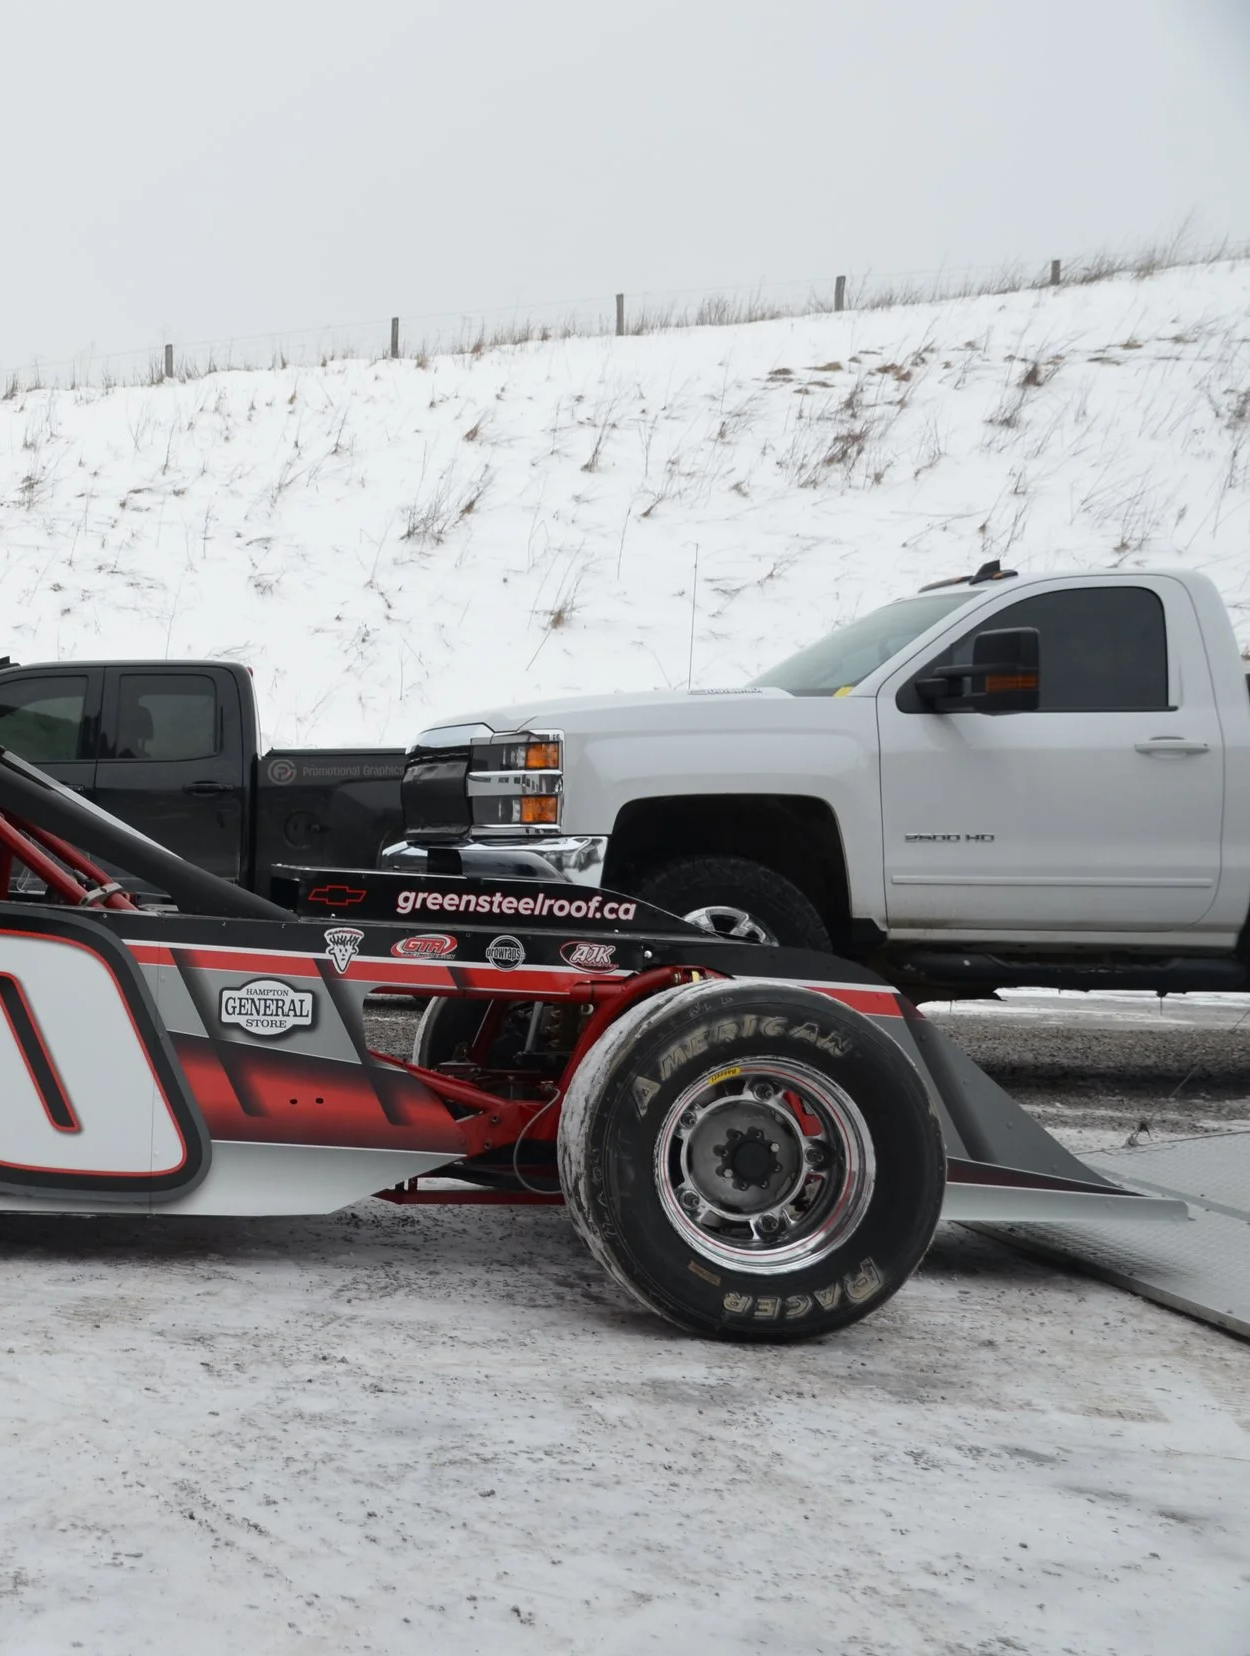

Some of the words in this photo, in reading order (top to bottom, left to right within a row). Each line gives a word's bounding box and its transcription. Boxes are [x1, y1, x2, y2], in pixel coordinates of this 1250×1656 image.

[303, 765, 360, 777] Promotional
[363, 765, 405, 777] Graphics
[905, 833, 960, 843] 2500
[965, 833, 995, 843] HD
[396, 890, 637, 920] greensteelroof.ca
[402, 937, 447, 954] GTA
[570, 943, 616, 964] AJK
[246, 988, 289, 997] HAMPTON
[224, 996, 310, 1018] GENERAL
[245, 1019, 287, 1029] STORE
[630, 1013, 854, 1121] AMERICAN
[722, 1257, 884, 1320] RACER
